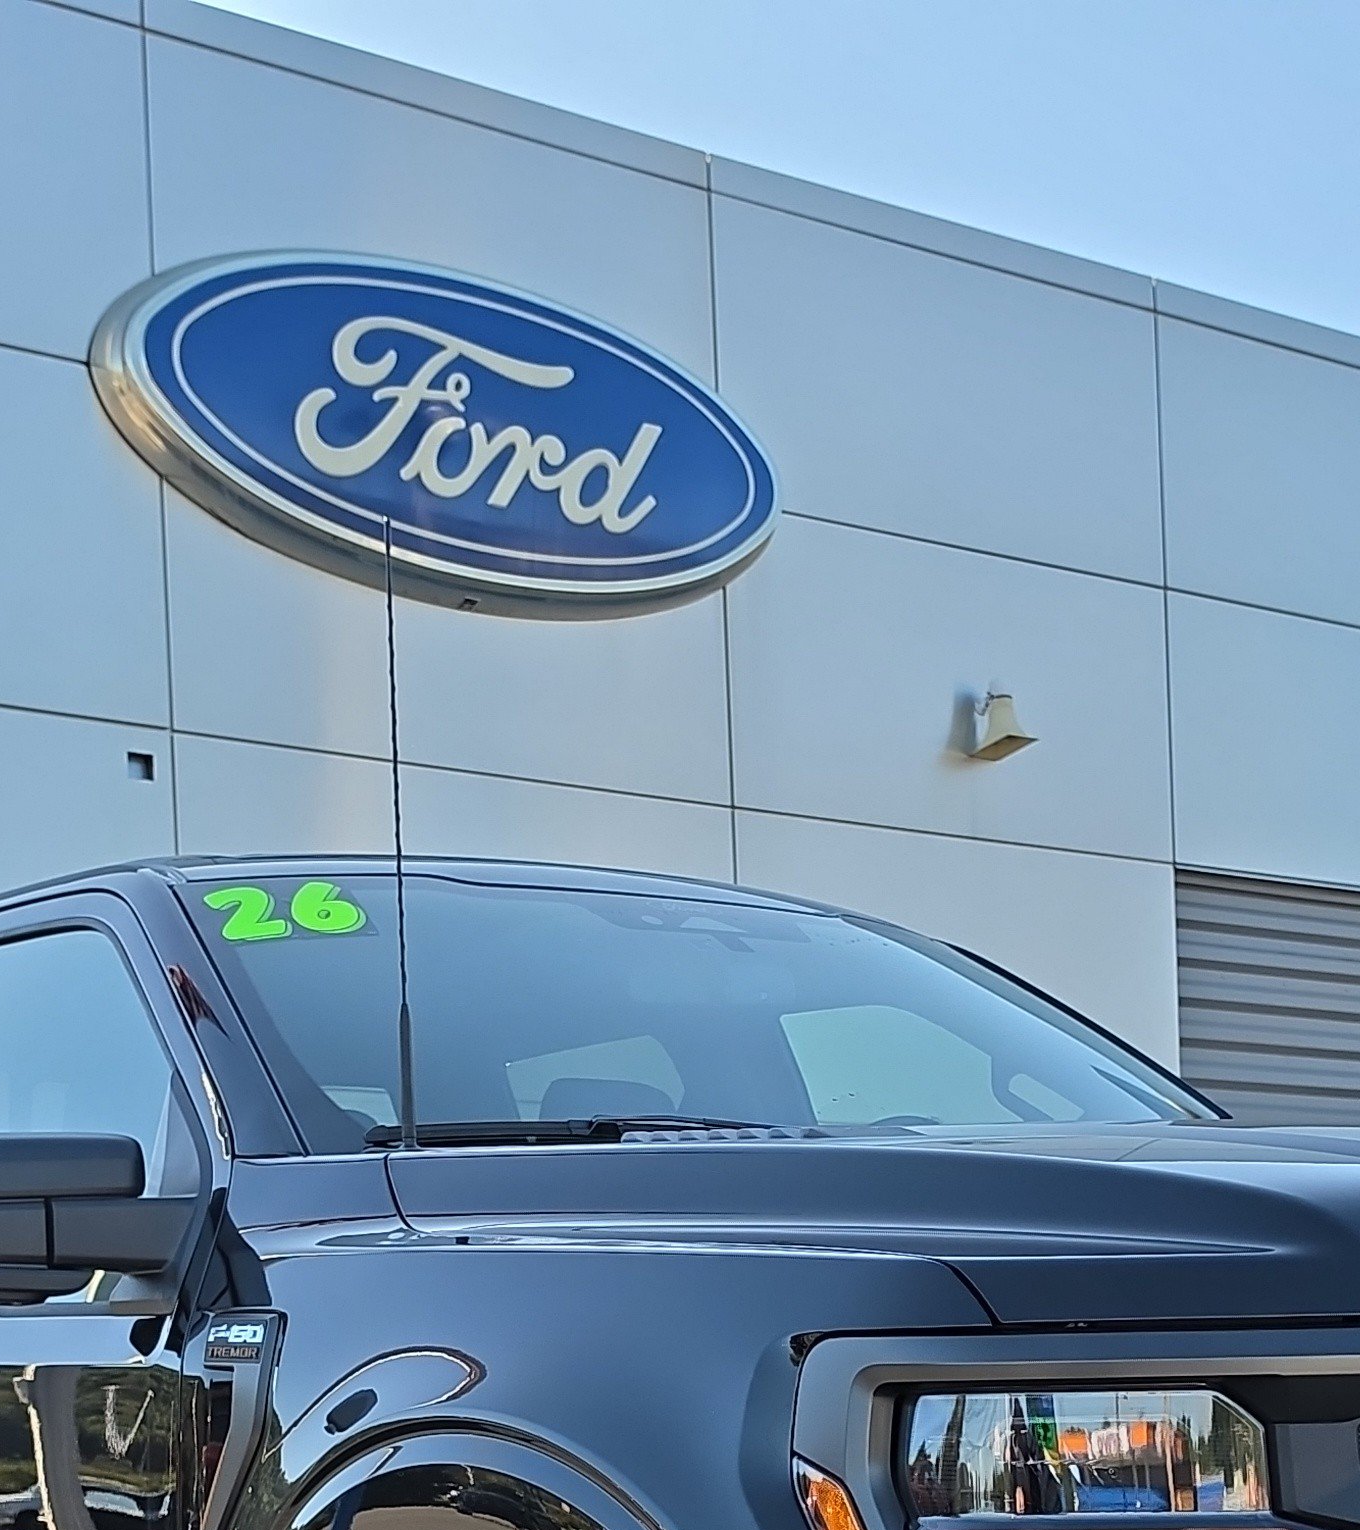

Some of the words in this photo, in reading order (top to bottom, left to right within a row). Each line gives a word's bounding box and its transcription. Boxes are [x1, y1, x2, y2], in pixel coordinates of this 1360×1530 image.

[295, 316, 663, 534] Ford
[203, 881, 368, 941] 26
[207, 1345, 258, 1359] TREMOR
